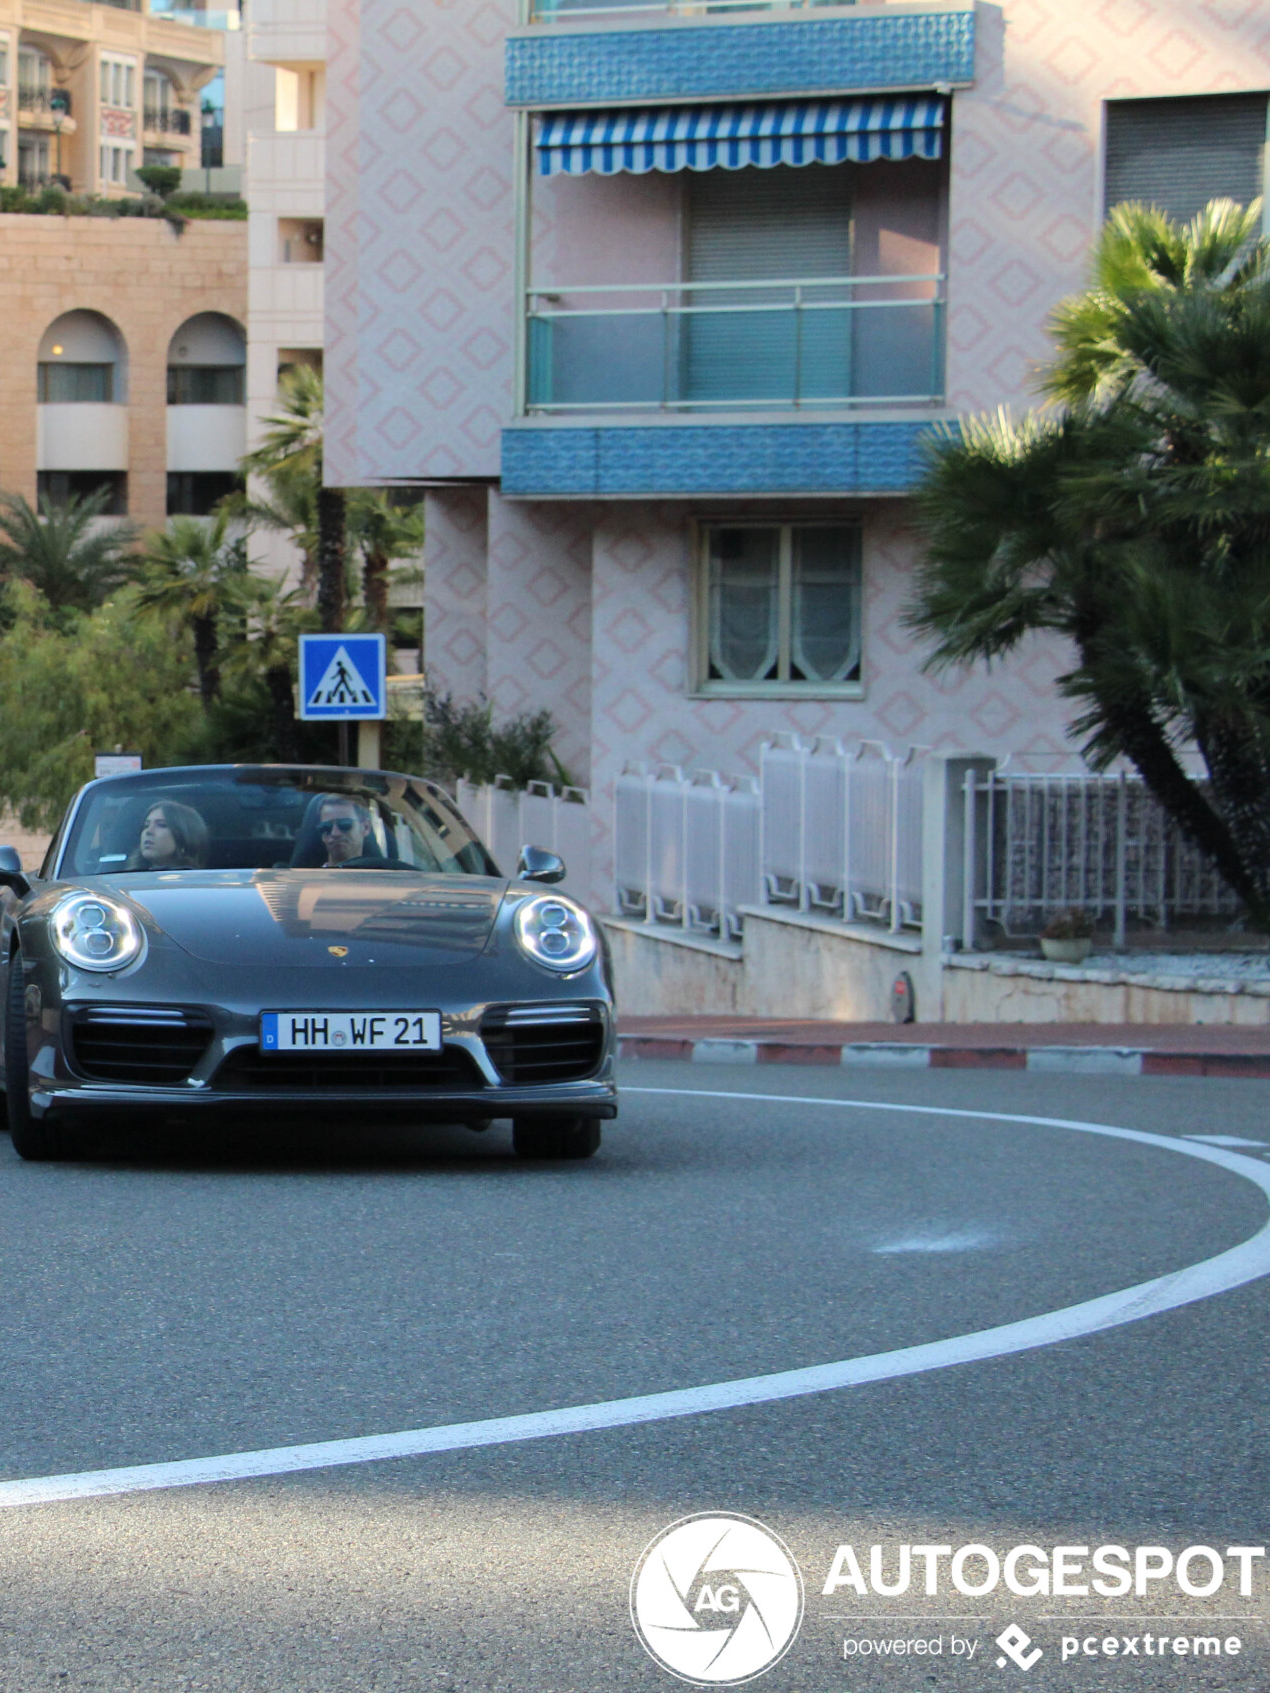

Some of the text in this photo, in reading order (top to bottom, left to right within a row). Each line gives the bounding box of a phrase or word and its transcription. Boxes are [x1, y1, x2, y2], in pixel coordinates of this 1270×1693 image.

[266, 1035, 274, 1044] D
[291, 1017, 428, 1045] HH WF 21
